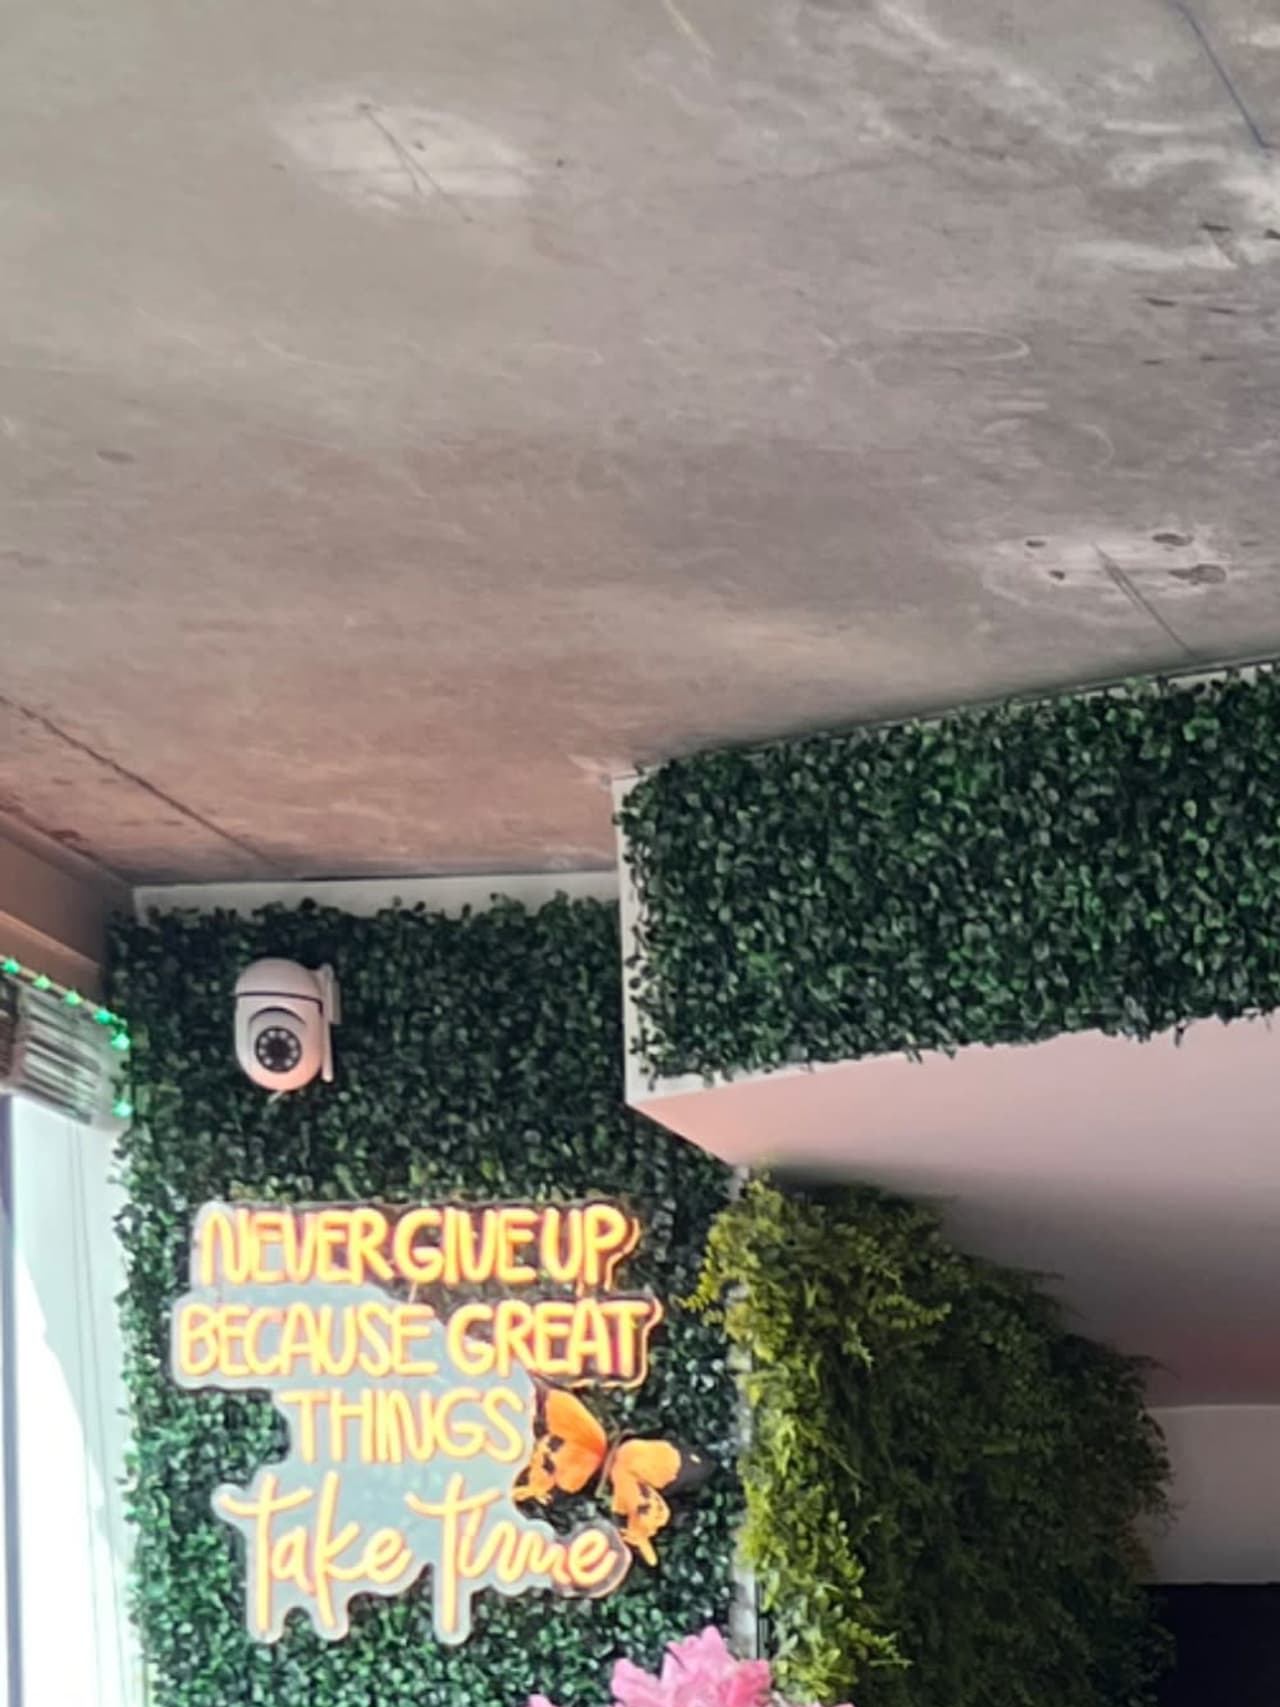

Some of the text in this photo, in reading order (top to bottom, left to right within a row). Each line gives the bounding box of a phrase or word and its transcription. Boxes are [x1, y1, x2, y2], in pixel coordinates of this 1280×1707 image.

[196, 1205, 628, 1285] NEVER GIVE UP
[178, 1299, 652, 1378] BECAUSE GREAT
[277, 1387, 527, 1465] THINGS
